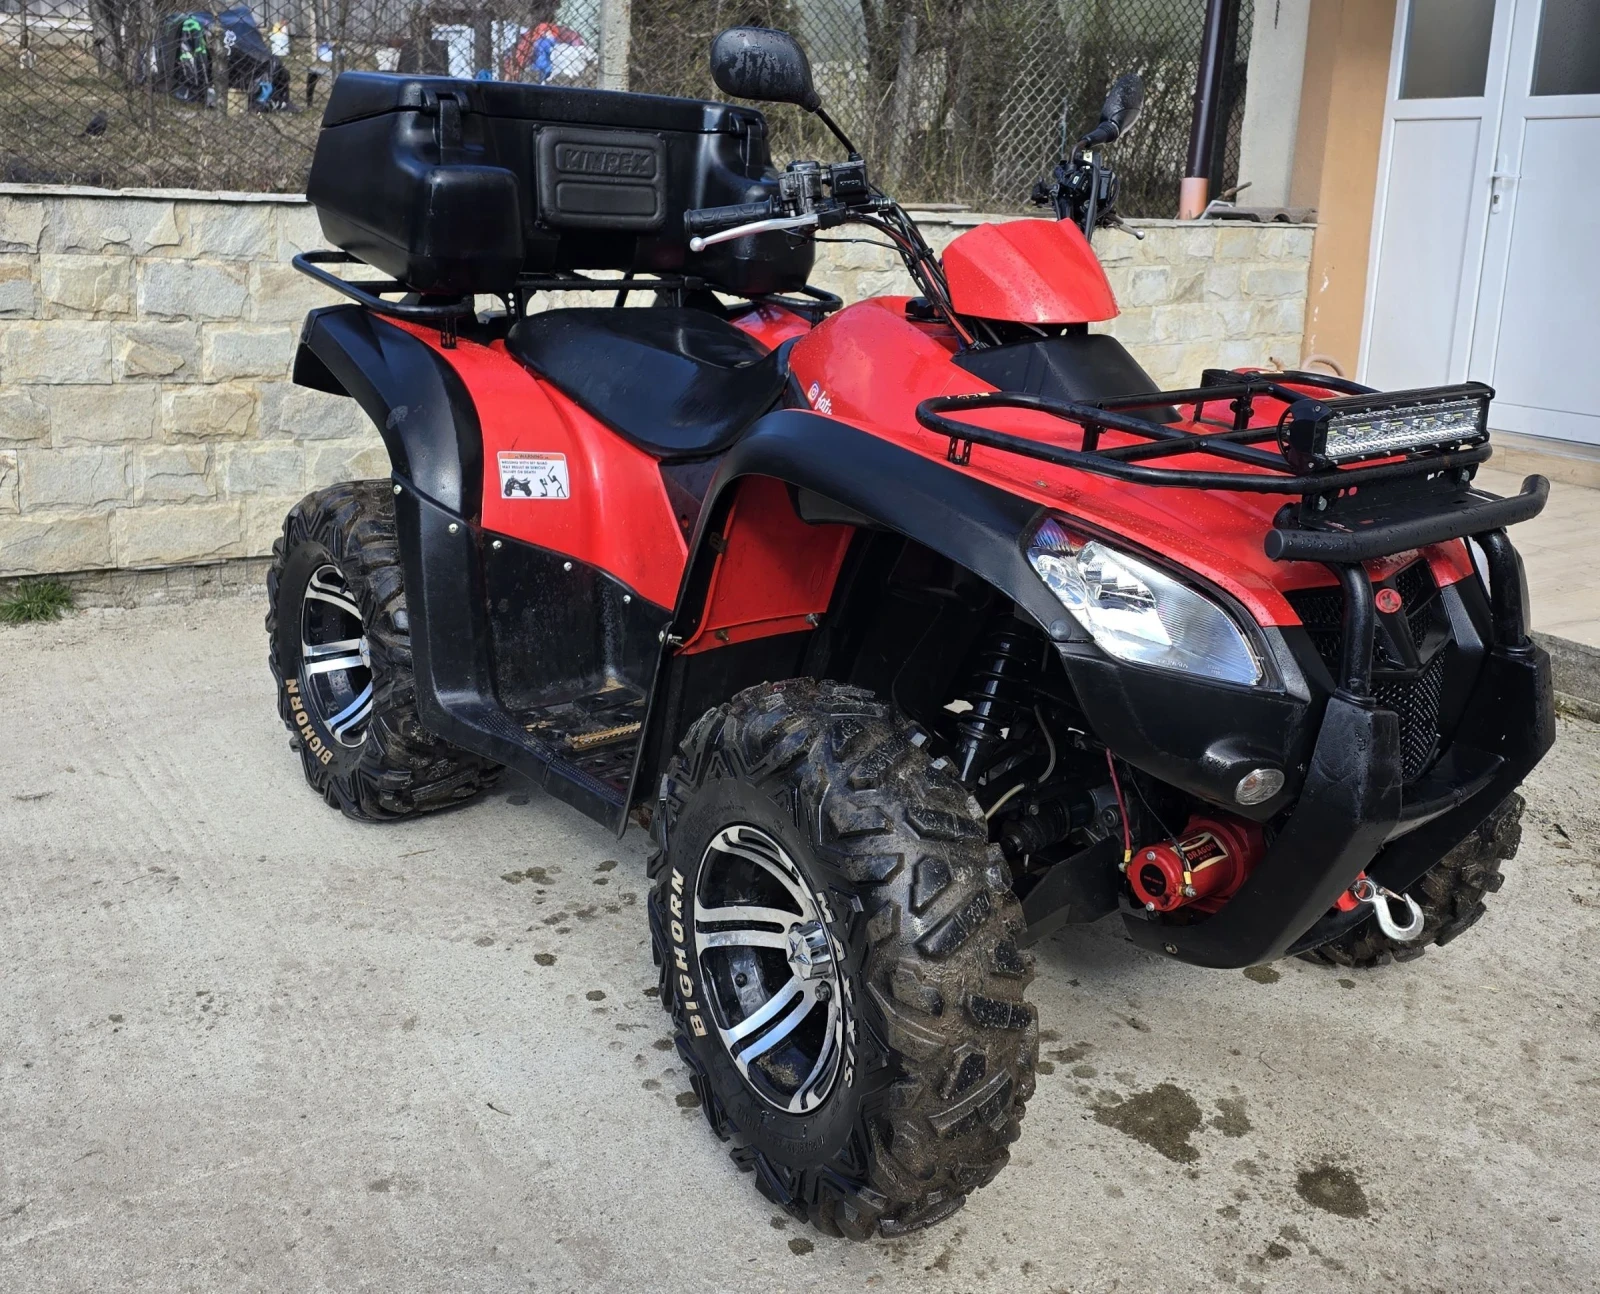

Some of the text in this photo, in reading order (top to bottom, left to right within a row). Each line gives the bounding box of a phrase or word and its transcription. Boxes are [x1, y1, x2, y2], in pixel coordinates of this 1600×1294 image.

[565, 148, 650, 174] KIMPEX
[285, 678, 334, 765] BIGHORN
[1186, 842, 1217, 860] DRAGON
[666, 867, 709, 1037] BIGHORN
